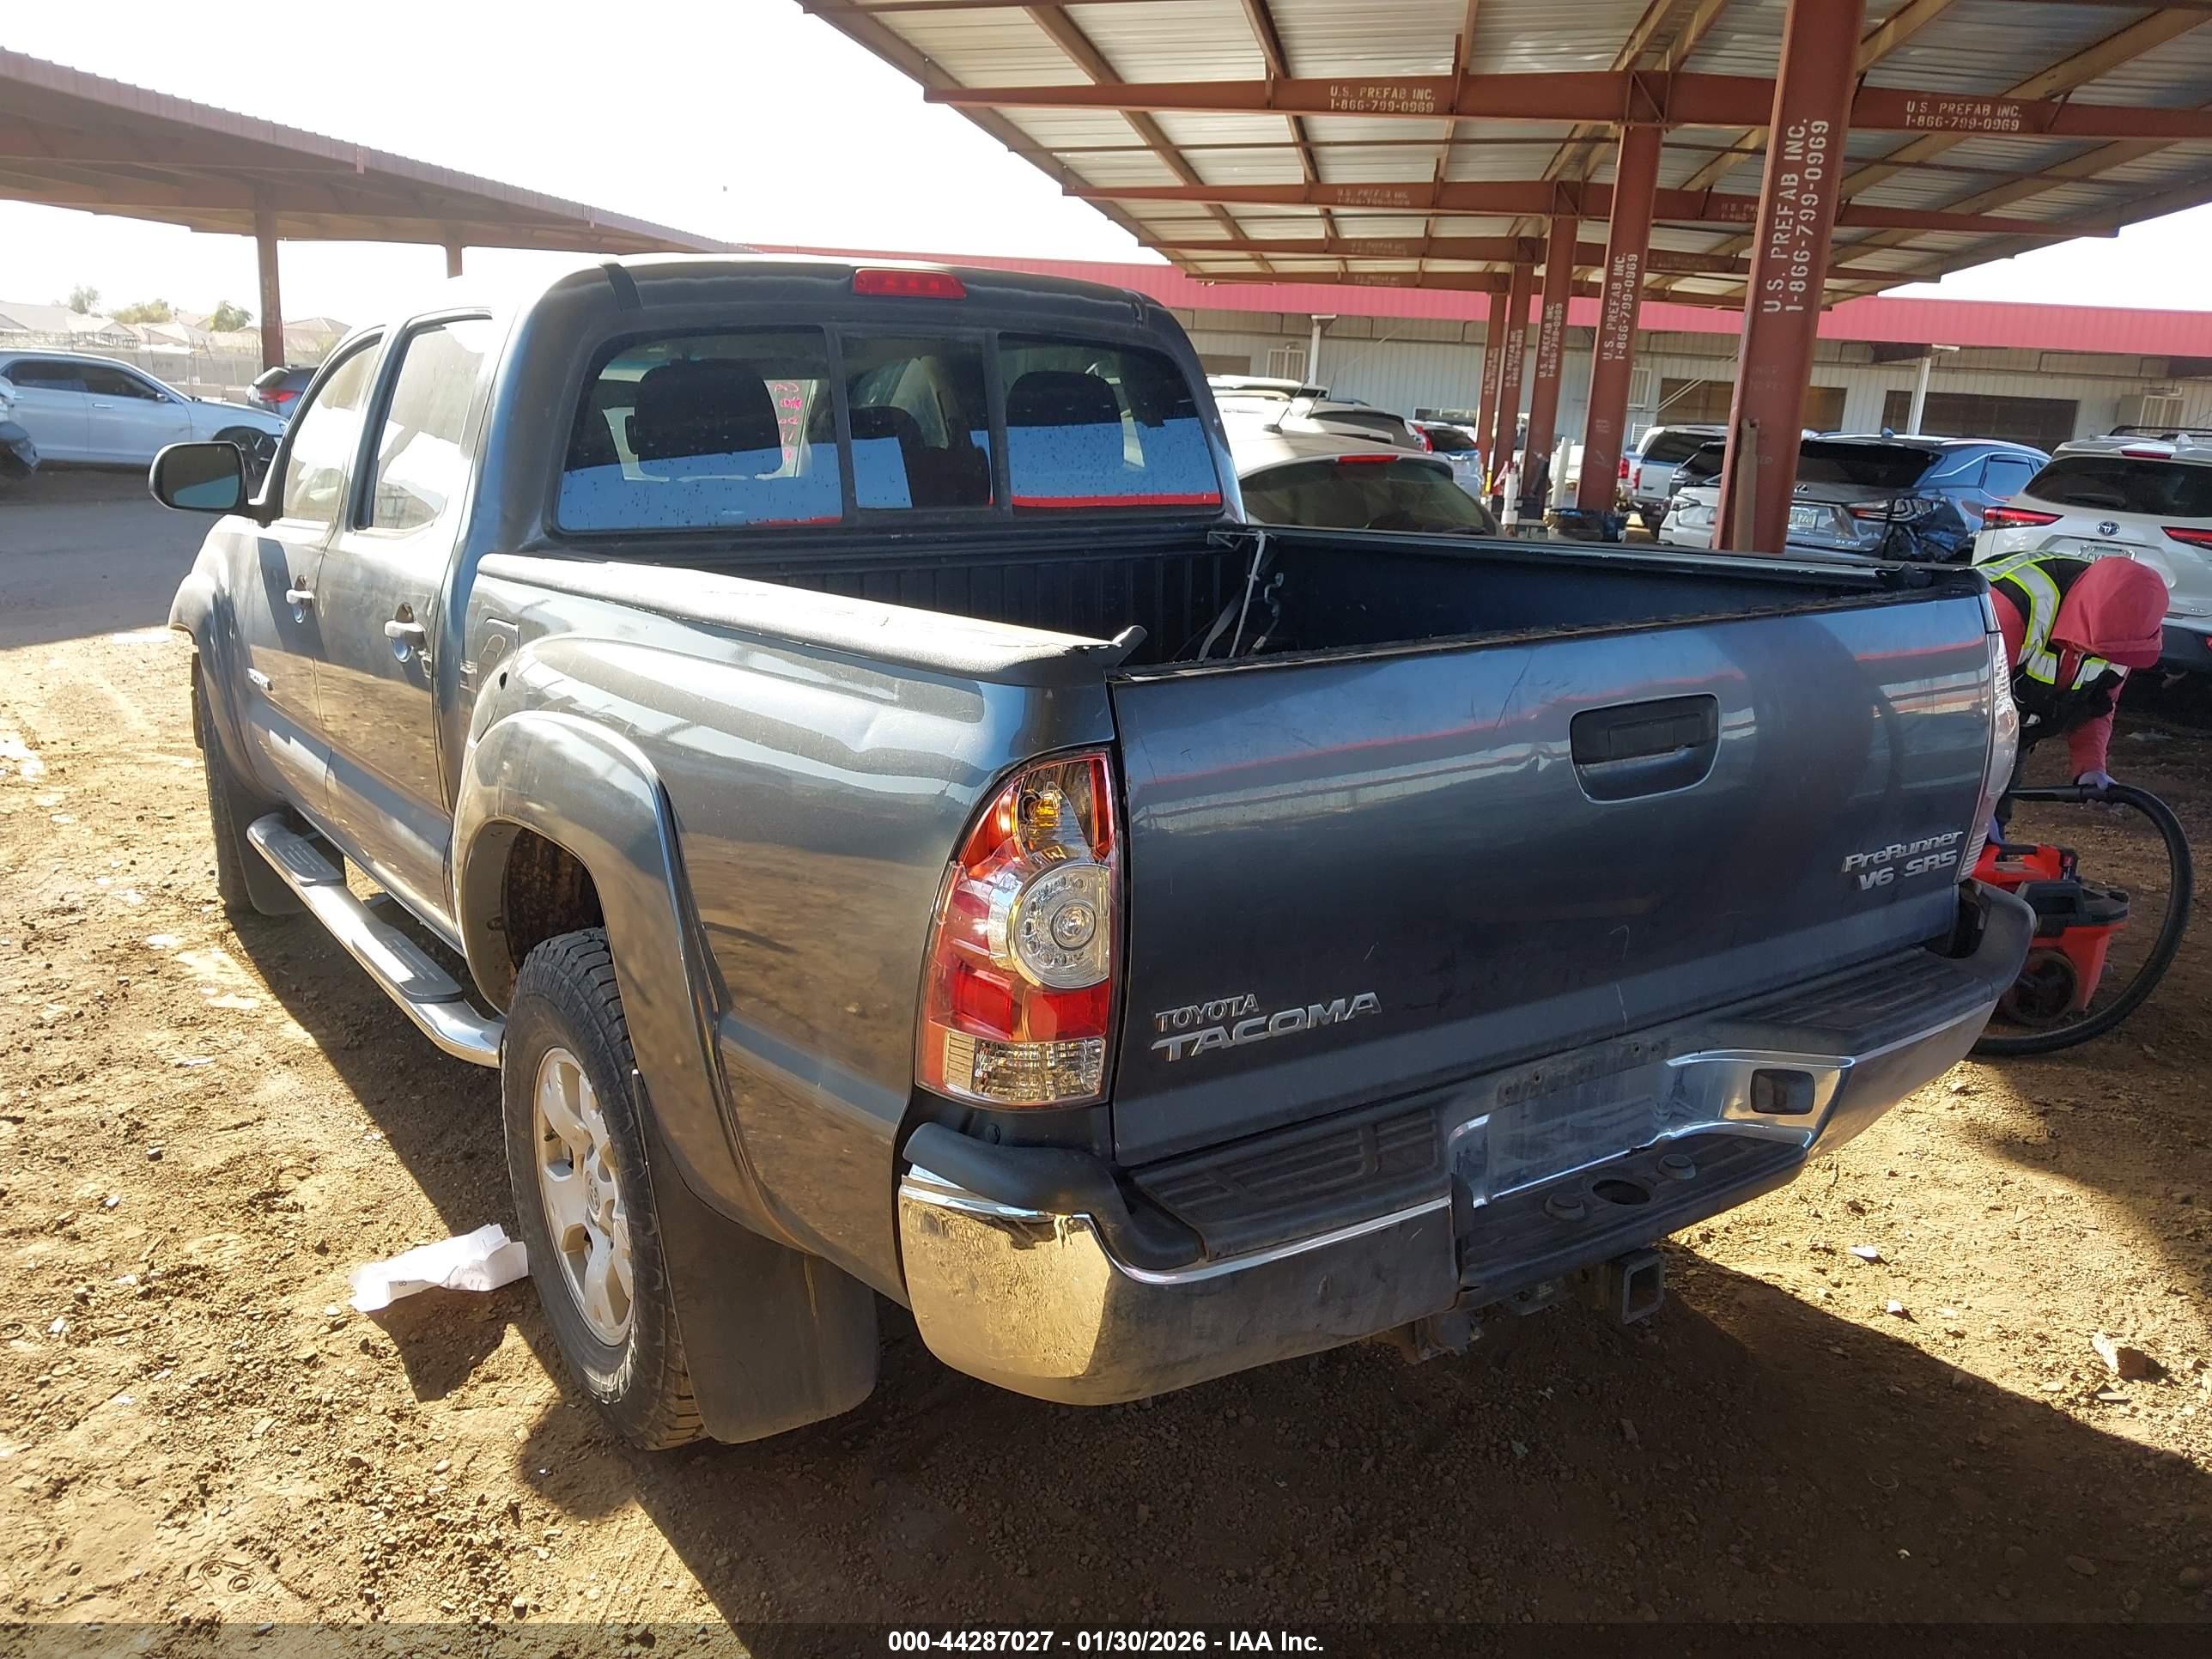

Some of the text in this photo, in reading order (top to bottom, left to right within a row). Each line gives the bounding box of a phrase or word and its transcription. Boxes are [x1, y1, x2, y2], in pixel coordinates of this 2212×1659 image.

[1330, 85, 1435, 100] U.S. PREFAB INC.
[1330, 99, 1434, 112] 1-866-799-0969
[1939, 102, 1991, 116] PREFAB
[1996, 105, 2022, 118] INC.
[1905, 114, 2020, 131] 1-866-799-0969
[1763, 118, 1808, 313] U.S. PREFAB INC.
[1785, 120, 1829, 312] 1-866-799-0969
[1602, 252, 1626, 361] U.S. PREFAB INC.
[1614, 253, 1638, 360] 1-866-799-0969
[1842, 831, 1964, 872] PreRunner
[1858, 849, 1957, 890] V6 SR5
[1151, 992, 1382, 1062] TACOMA
[1155, 994, 1260, 1032] TOYOTA
